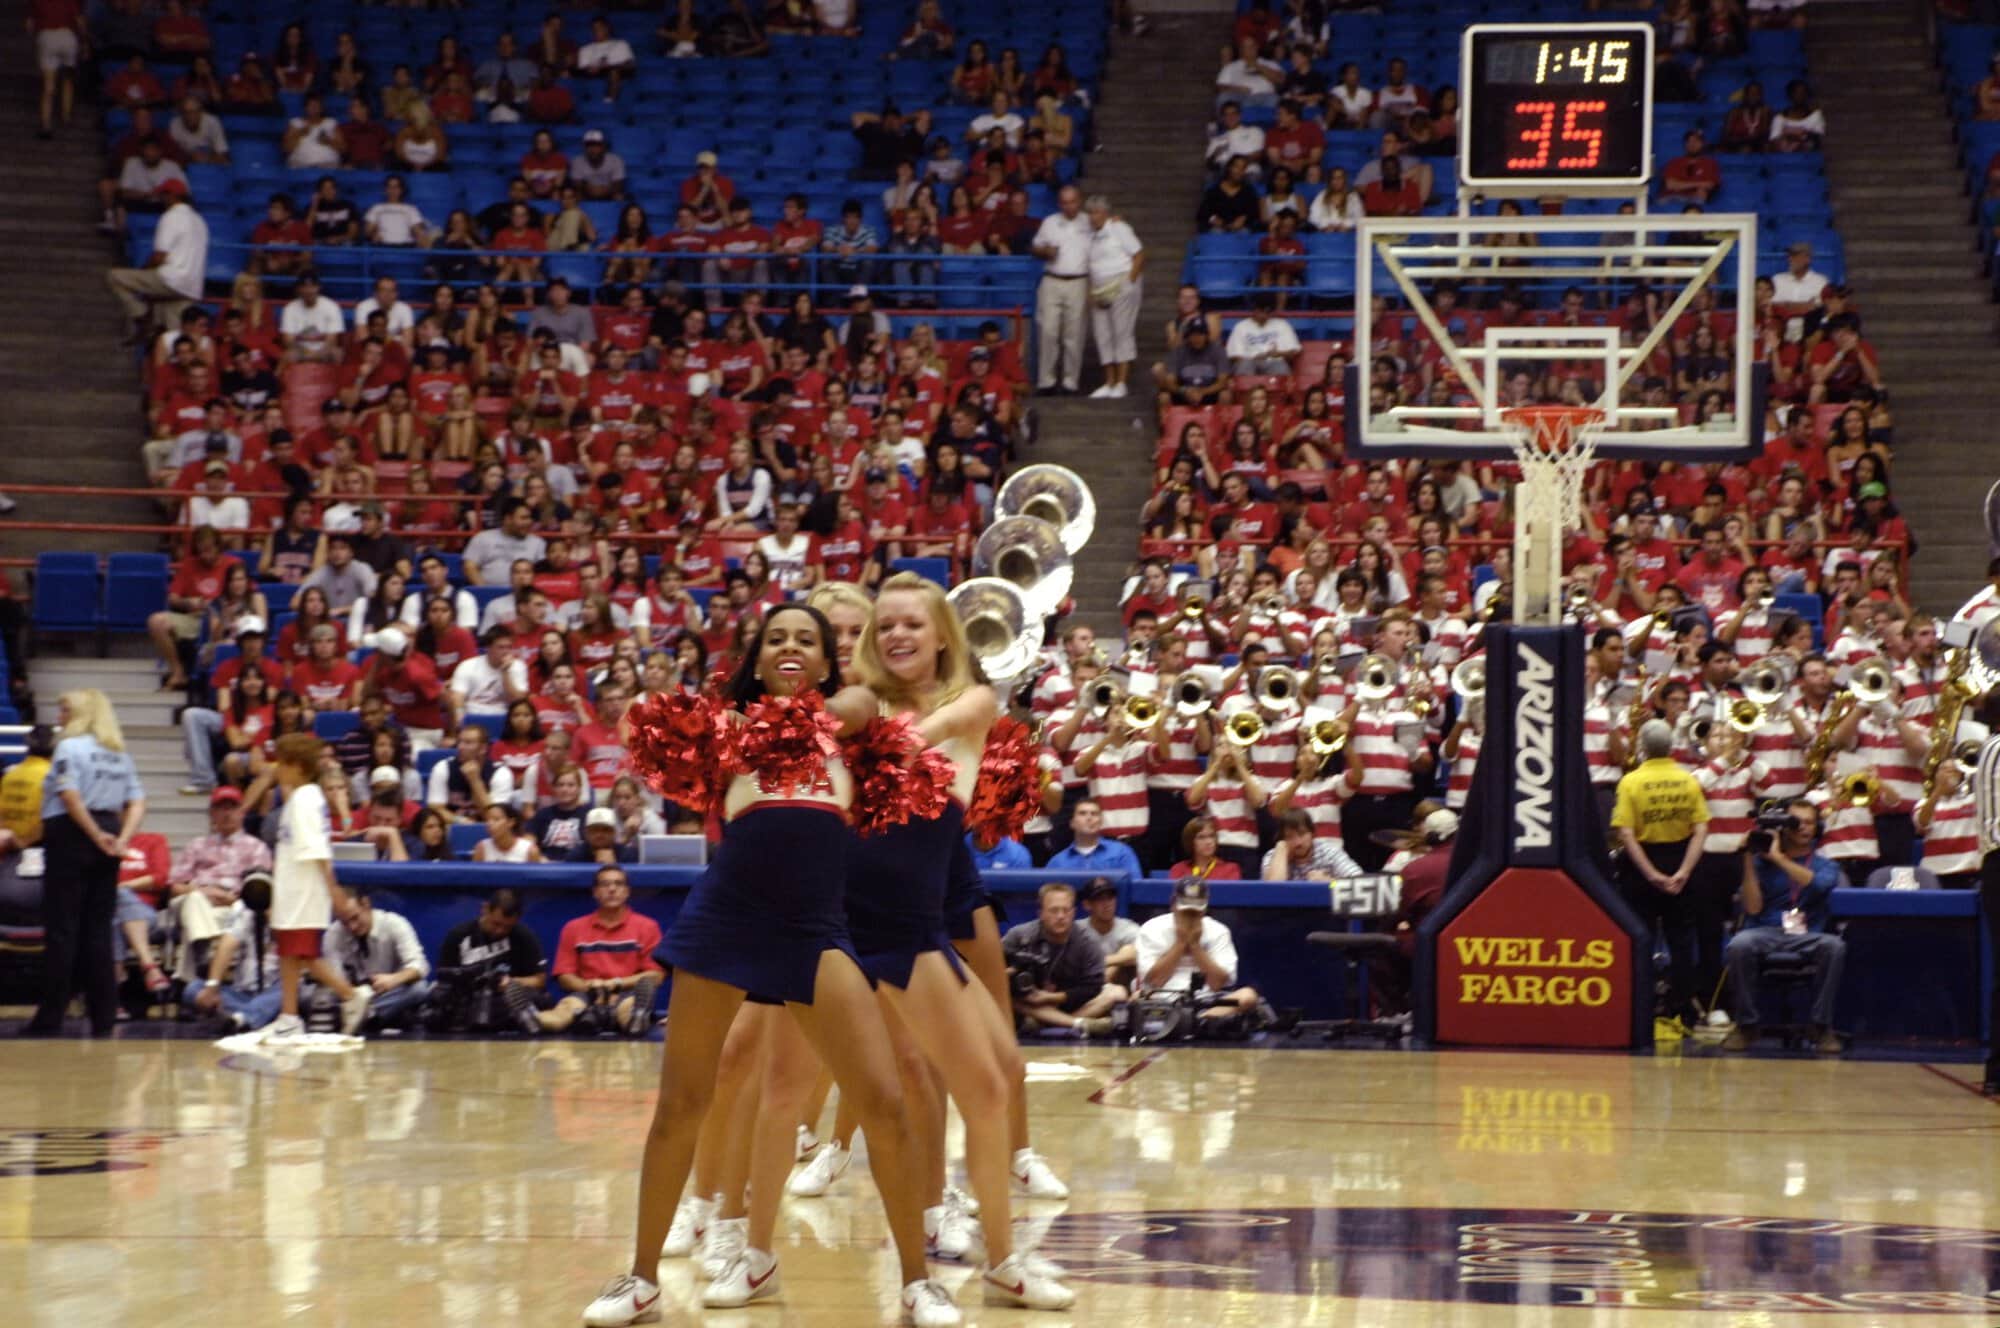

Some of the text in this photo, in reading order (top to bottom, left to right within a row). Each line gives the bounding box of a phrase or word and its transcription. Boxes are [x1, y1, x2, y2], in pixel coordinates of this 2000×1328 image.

[1535, 41, 1630, 84] 1:45
[1507, 101, 1606, 169] 35
[1514, 641, 1554, 852] ARIZONA
[1332, 876, 1403, 914] FSN
[1453, 936, 1614, 968] WELLS
[1458, 974, 1611, 1006] FARGO
